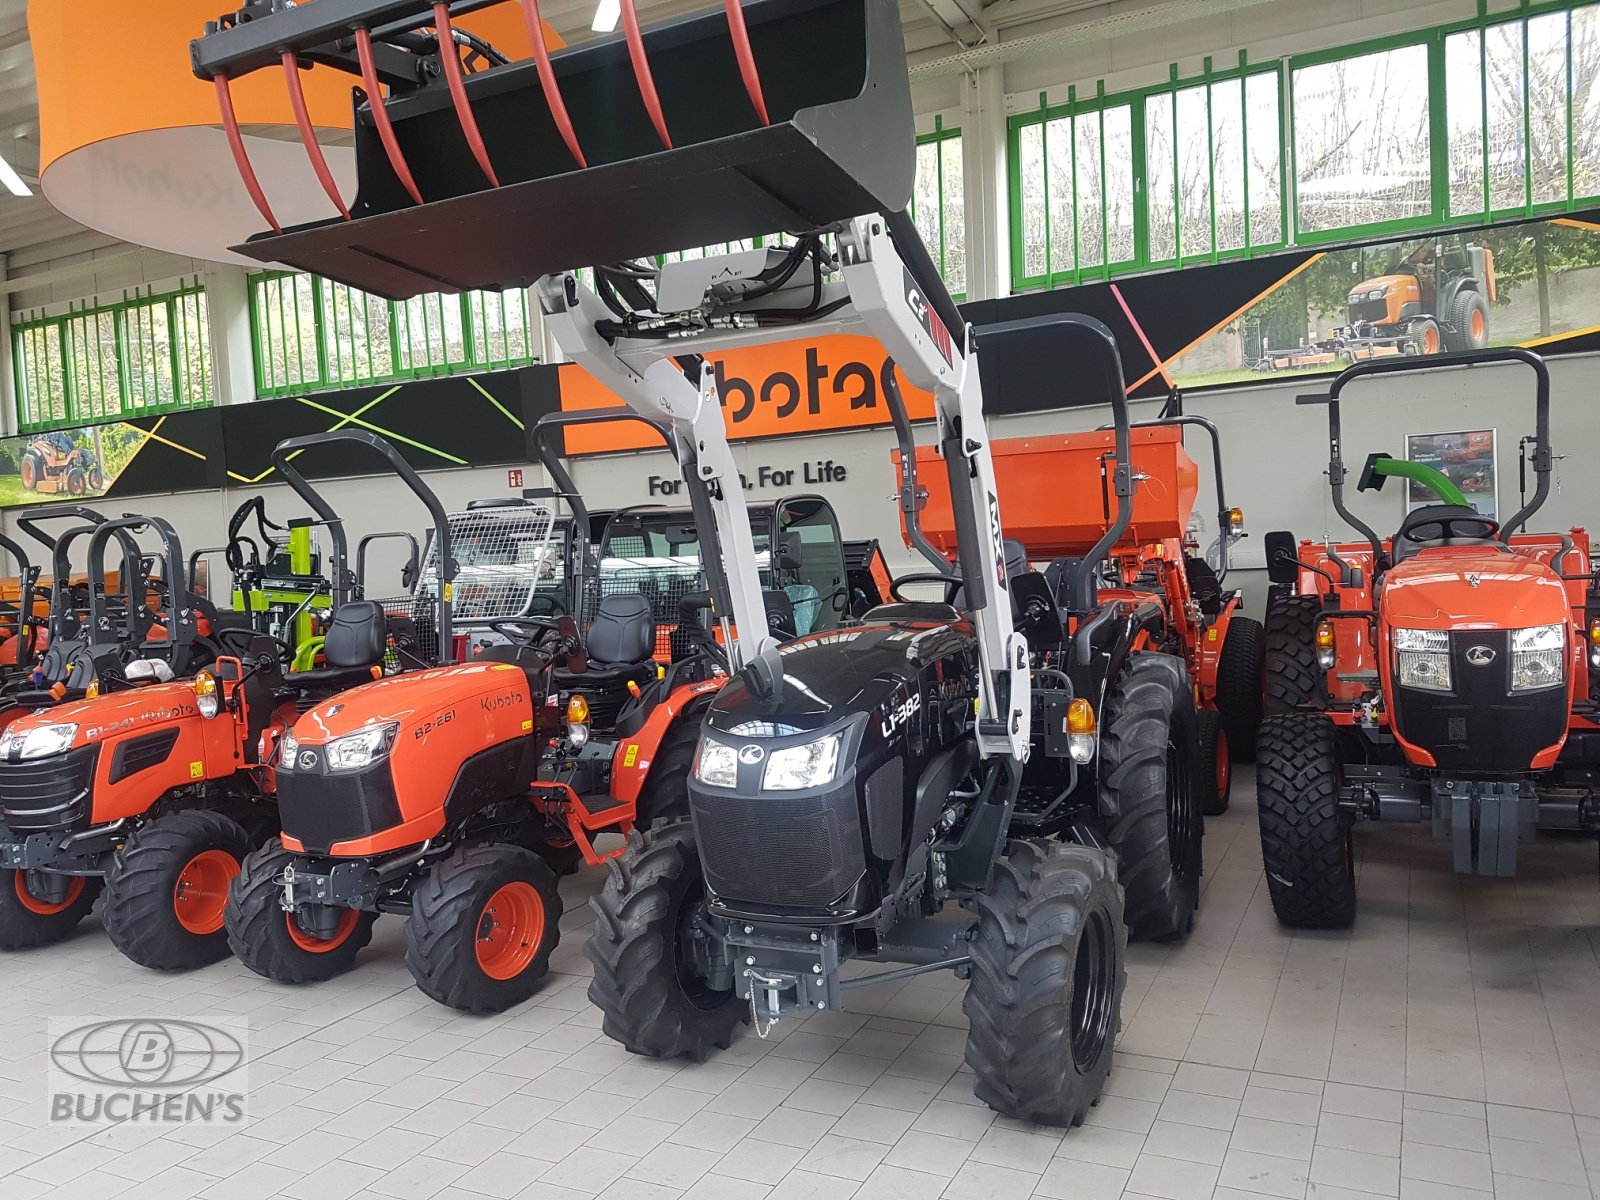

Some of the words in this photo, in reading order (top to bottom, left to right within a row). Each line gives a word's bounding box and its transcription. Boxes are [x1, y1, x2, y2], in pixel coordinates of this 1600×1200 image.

[714, 347, 877, 424] bota
[648, 475, 682, 496] For
[758, 466, 795, 488] For
[803, 460, 847, 484] Life
[990, 501, 1002, 561] MX
[86, 717, 135, 740] B1-241
[414, 709, 456, 740] B2-261
[480, 691, 523, 711] Kubota
[881, 692, 921, 738] L1-382
